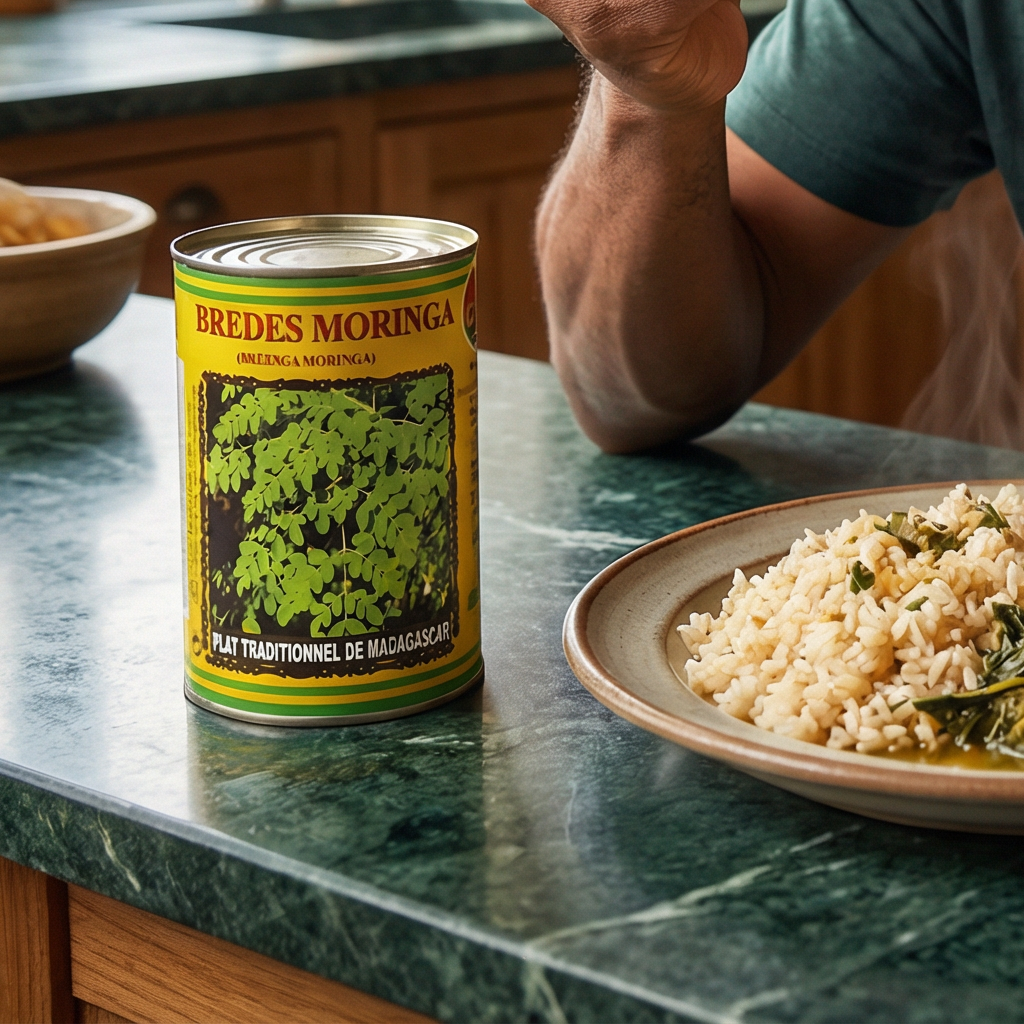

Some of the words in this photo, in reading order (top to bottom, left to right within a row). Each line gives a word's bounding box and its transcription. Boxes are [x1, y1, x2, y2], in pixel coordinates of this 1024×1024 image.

[196, 304, 303, 342] BREDES
[312, 298, 454, 343] MORINGA
[303, 352, 376, 367] MORINGA)
[212, 632, 238, 657] PLAT
[241, 638, 340, 662] TRADITIONNEL
[346, 641, 364, 660] DE
[368, 621, 451, 659] MADAGASCAR
